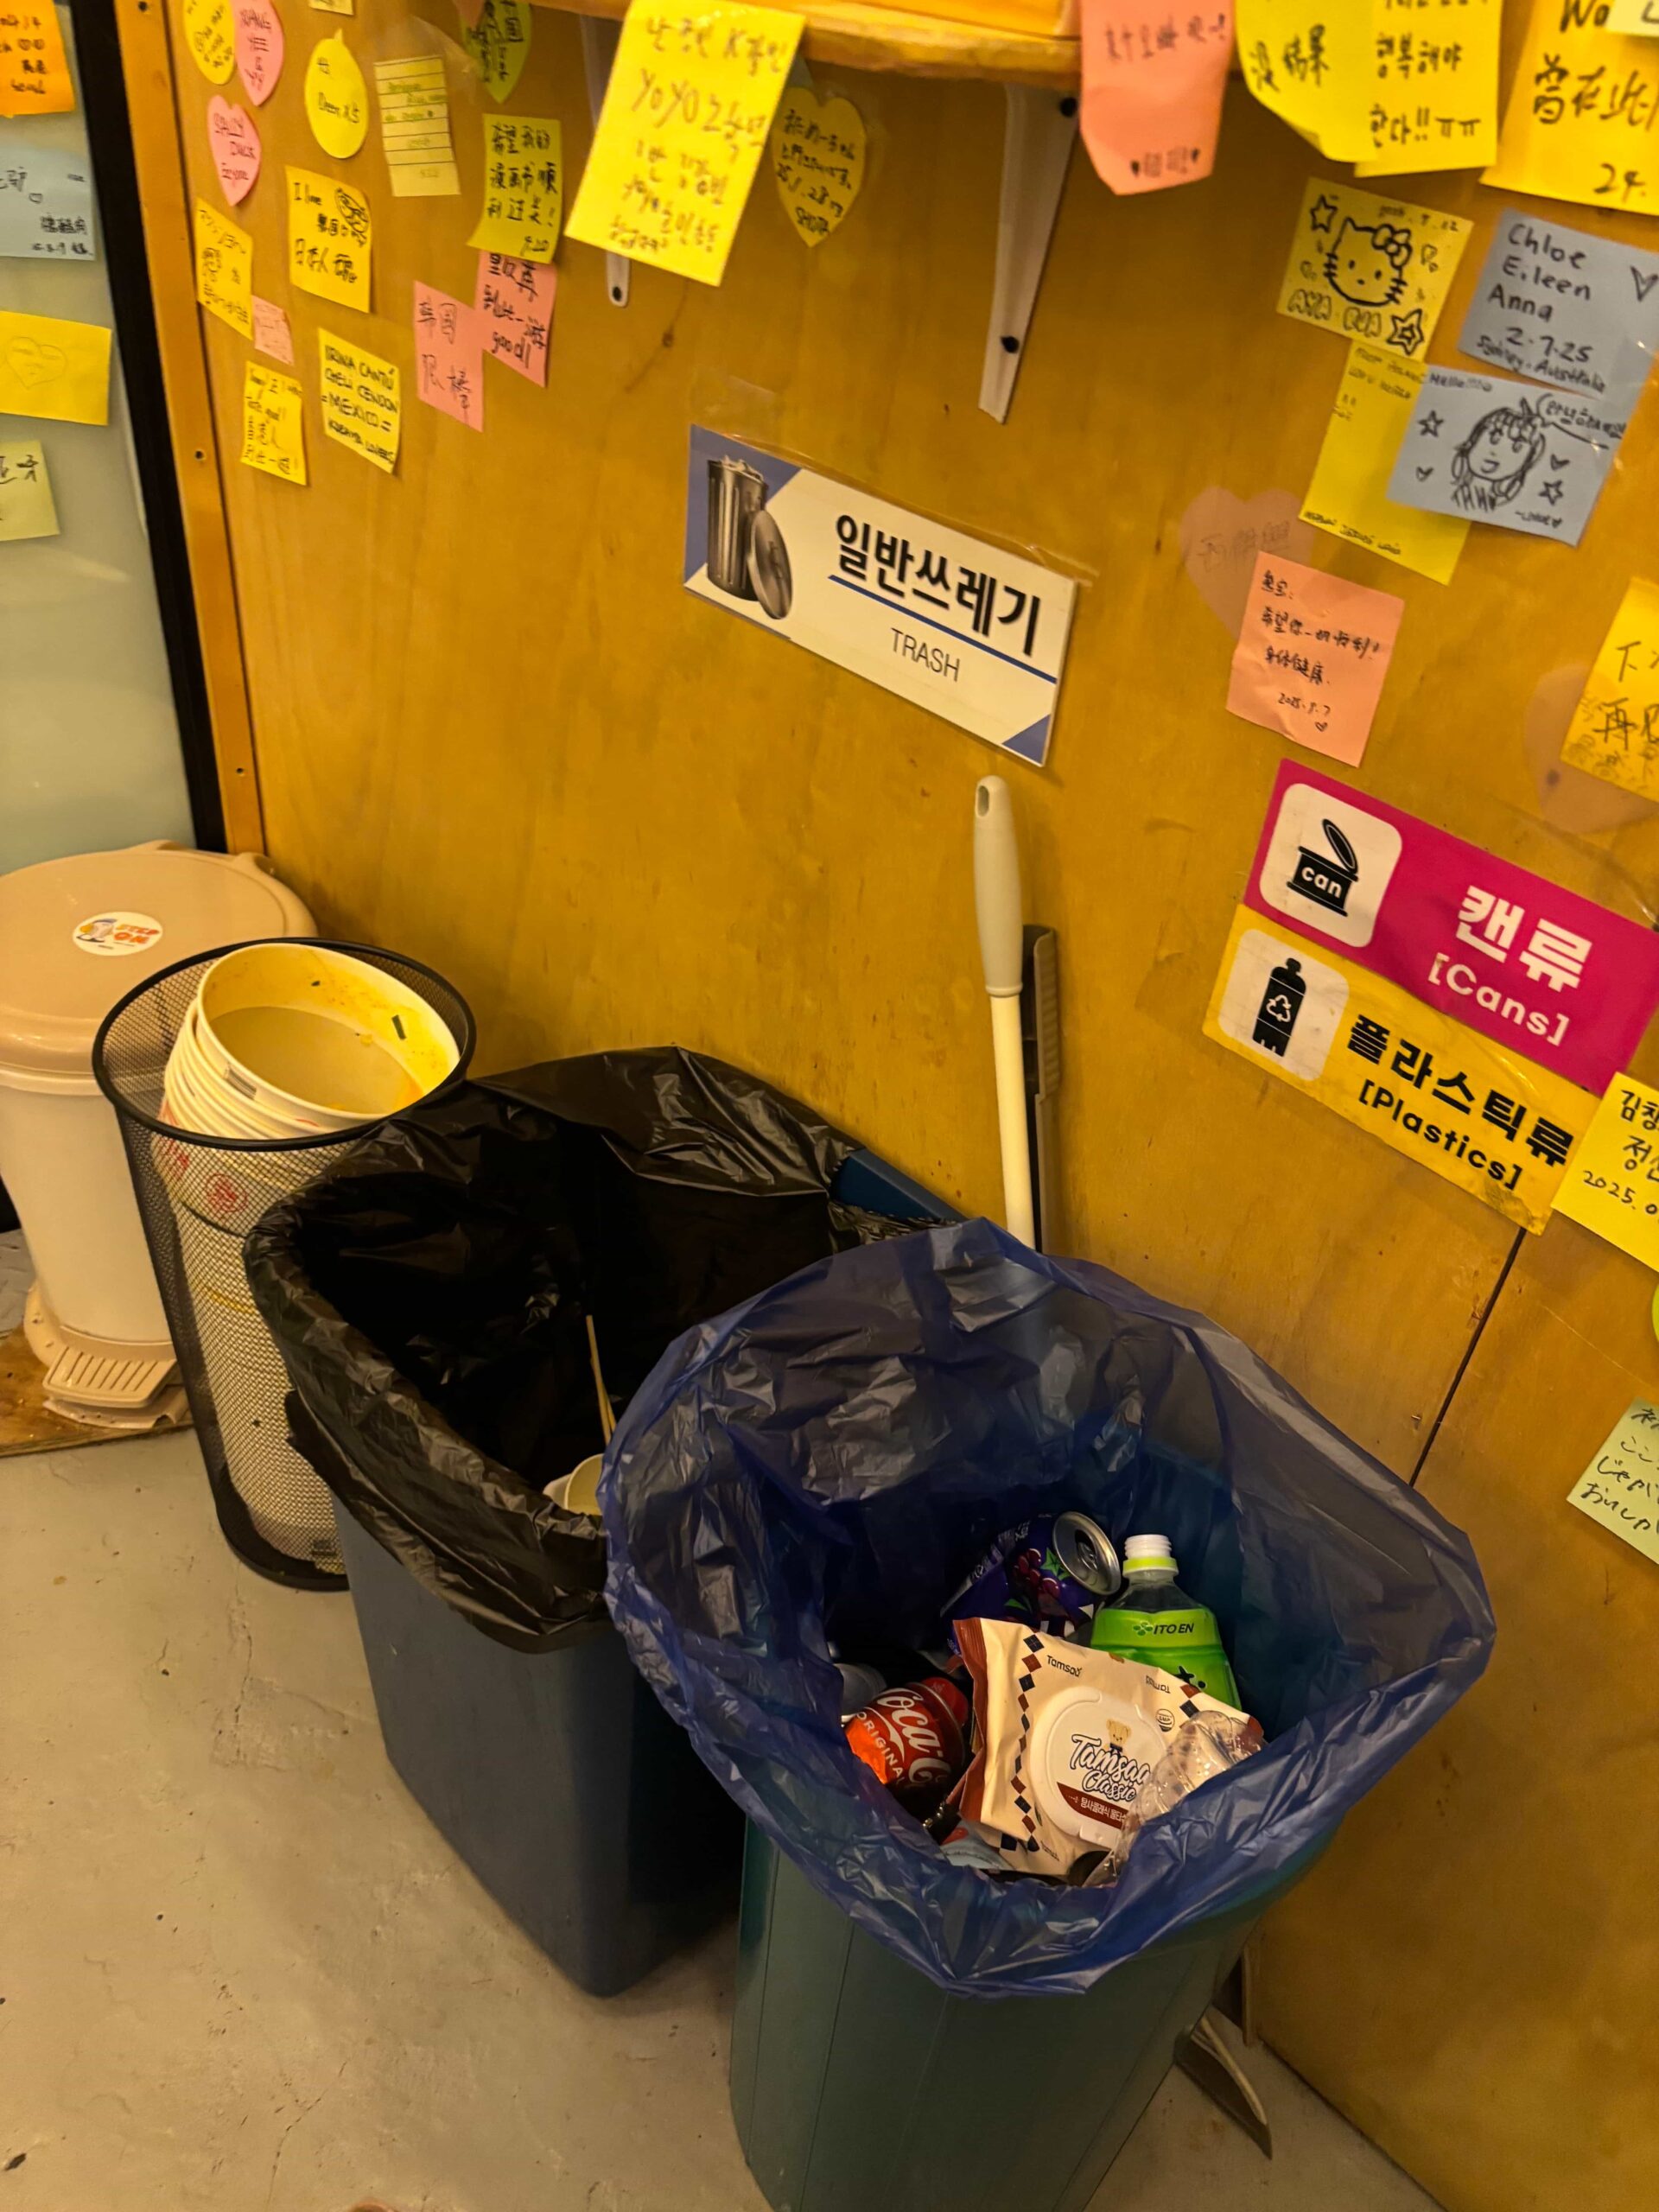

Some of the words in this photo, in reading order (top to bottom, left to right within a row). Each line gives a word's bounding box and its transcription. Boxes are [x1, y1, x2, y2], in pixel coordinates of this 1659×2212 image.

[1508, 223, 1586, 269] Chloe
[1488, 283, 1554, 322] Anna
[836, 514, 1041, 657] 일반쓰레기
[891, 628, 960, 682] TRASH
[1301, 864, 1343, 899] can
[1455, 885, 1592, 993] 캔류
[1427, 952, 1570, 1046] [Cans]
[1347, 1014, 1574, 1166] 플라스틱류
[1358, 1079, 1522, 1191] [Plastics]
[1154, 1624, 1176, 1635] ITO
[1178, 1624, 1194, 1634] EN
[1082, 1769, 1137, 1802] Classic
